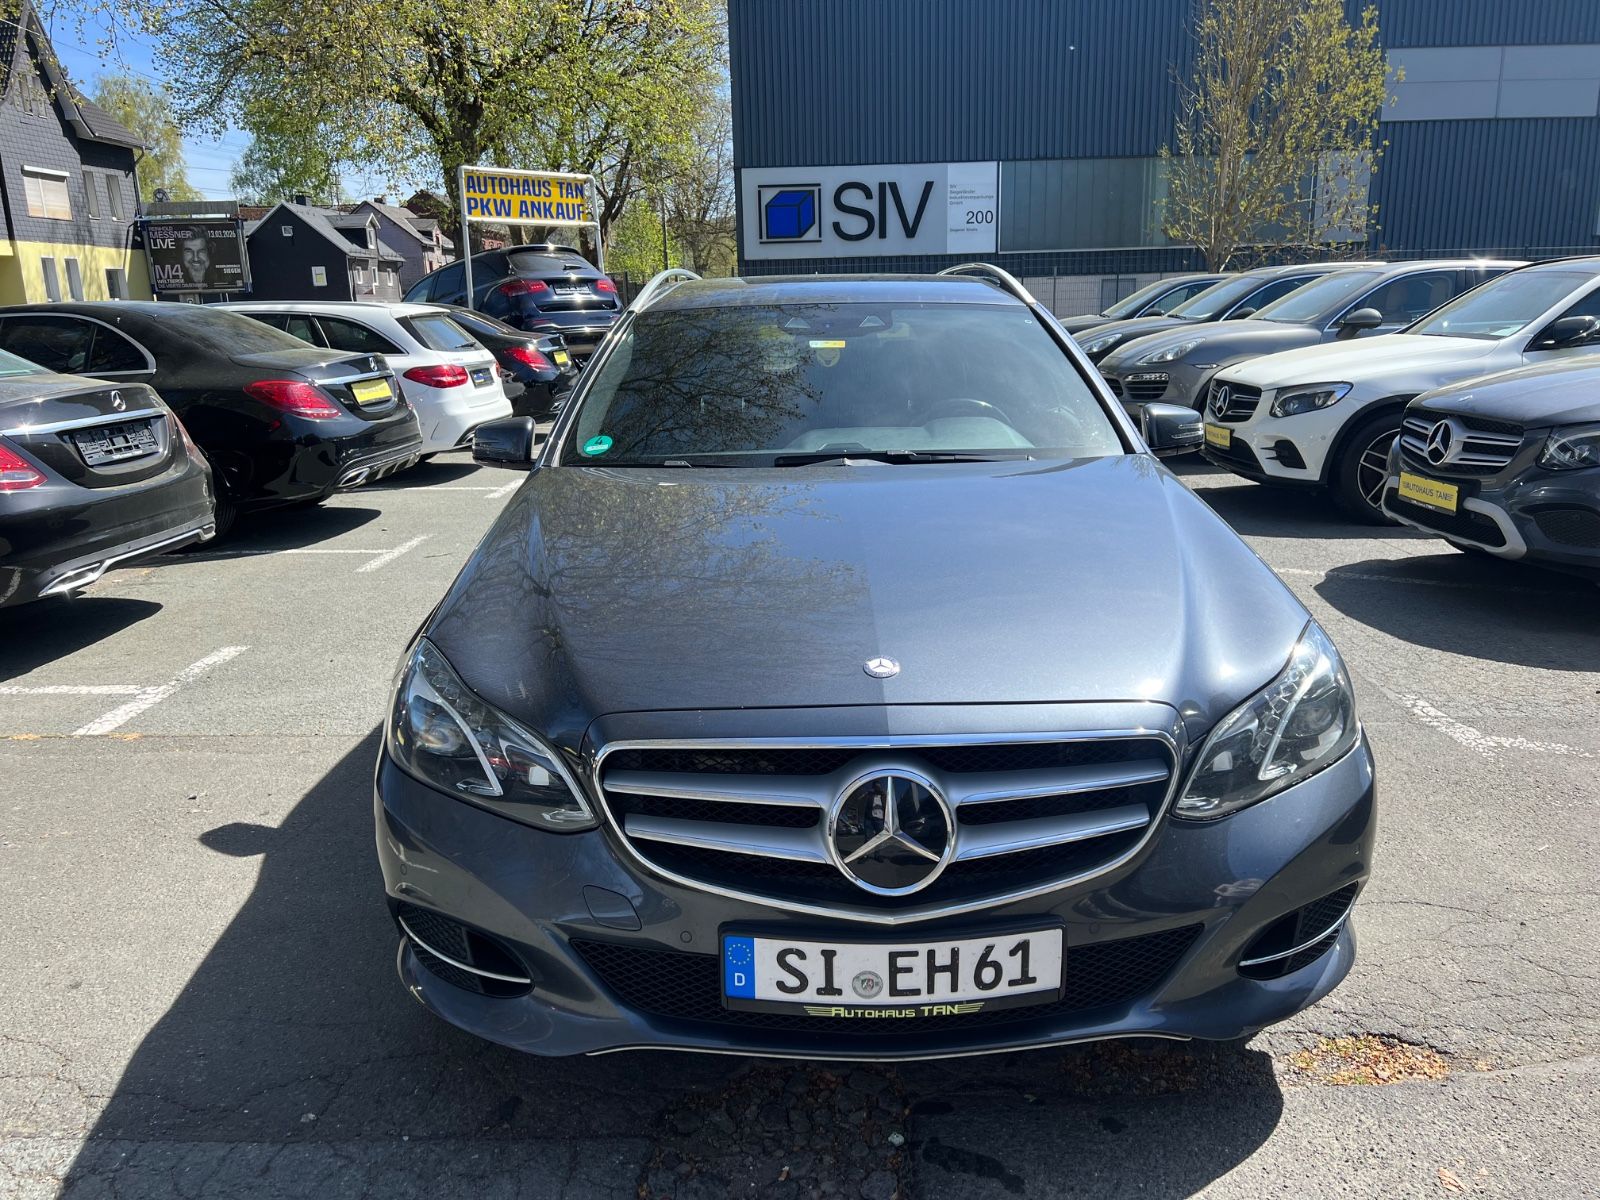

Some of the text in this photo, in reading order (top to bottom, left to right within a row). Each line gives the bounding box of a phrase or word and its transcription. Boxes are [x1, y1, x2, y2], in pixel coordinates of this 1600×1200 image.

[466, 175, 585, 200] AUTOHAUS TAN
[466, 196, 585, 220] PKW ANKAUF
[832, 181, 934, 242] SIV
[966, 210, 994, 225] 200
[149, 230, 193, 239] MESSNER
[151, 238, 176, 249] LIVE
[154, 264, 184, 280] M4
[594, 436, 603, 445] 4
[1405, 481, 1449, 501] AUTOHAUS TAN
[734, 973, 746, 986] D
[775, 947, 843, 997] SI
[888, 947, 959, 997] EH
[973, 939, 1037, 990] 61
[920, 1005, 959, 1016] TAN
